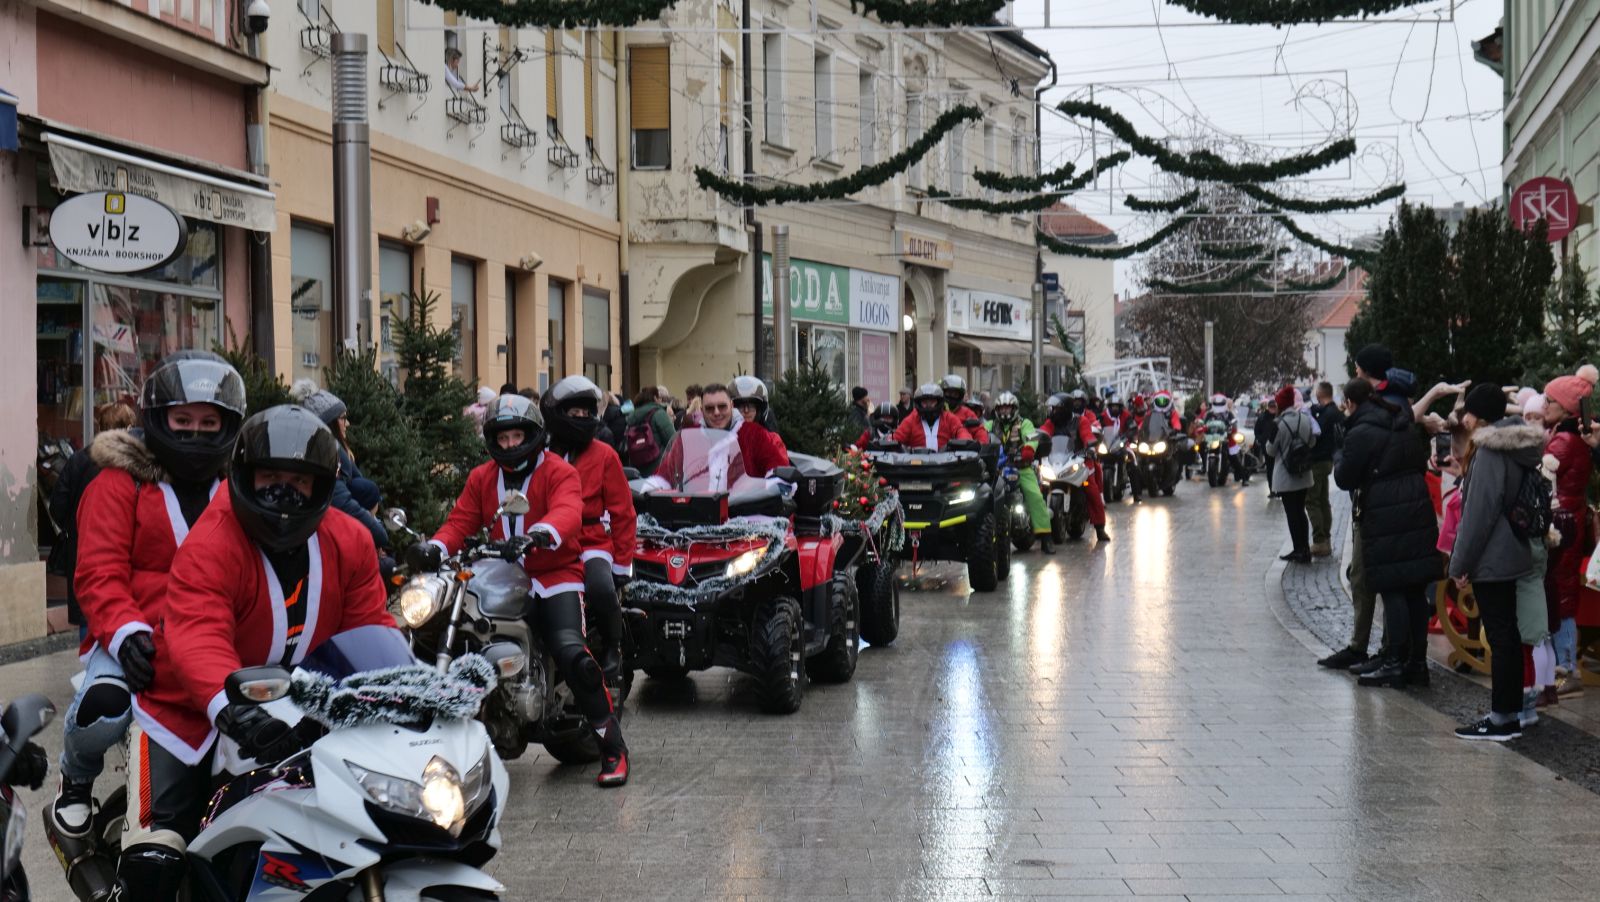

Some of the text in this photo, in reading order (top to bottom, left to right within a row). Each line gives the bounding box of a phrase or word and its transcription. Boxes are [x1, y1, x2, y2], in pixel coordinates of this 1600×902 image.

[65, 246, 164, 260] KNJIŽARA BOOKSHOP
[909, 237, 938, 262] OLD CITY
[860, 300, 890, 326] LOGOS
